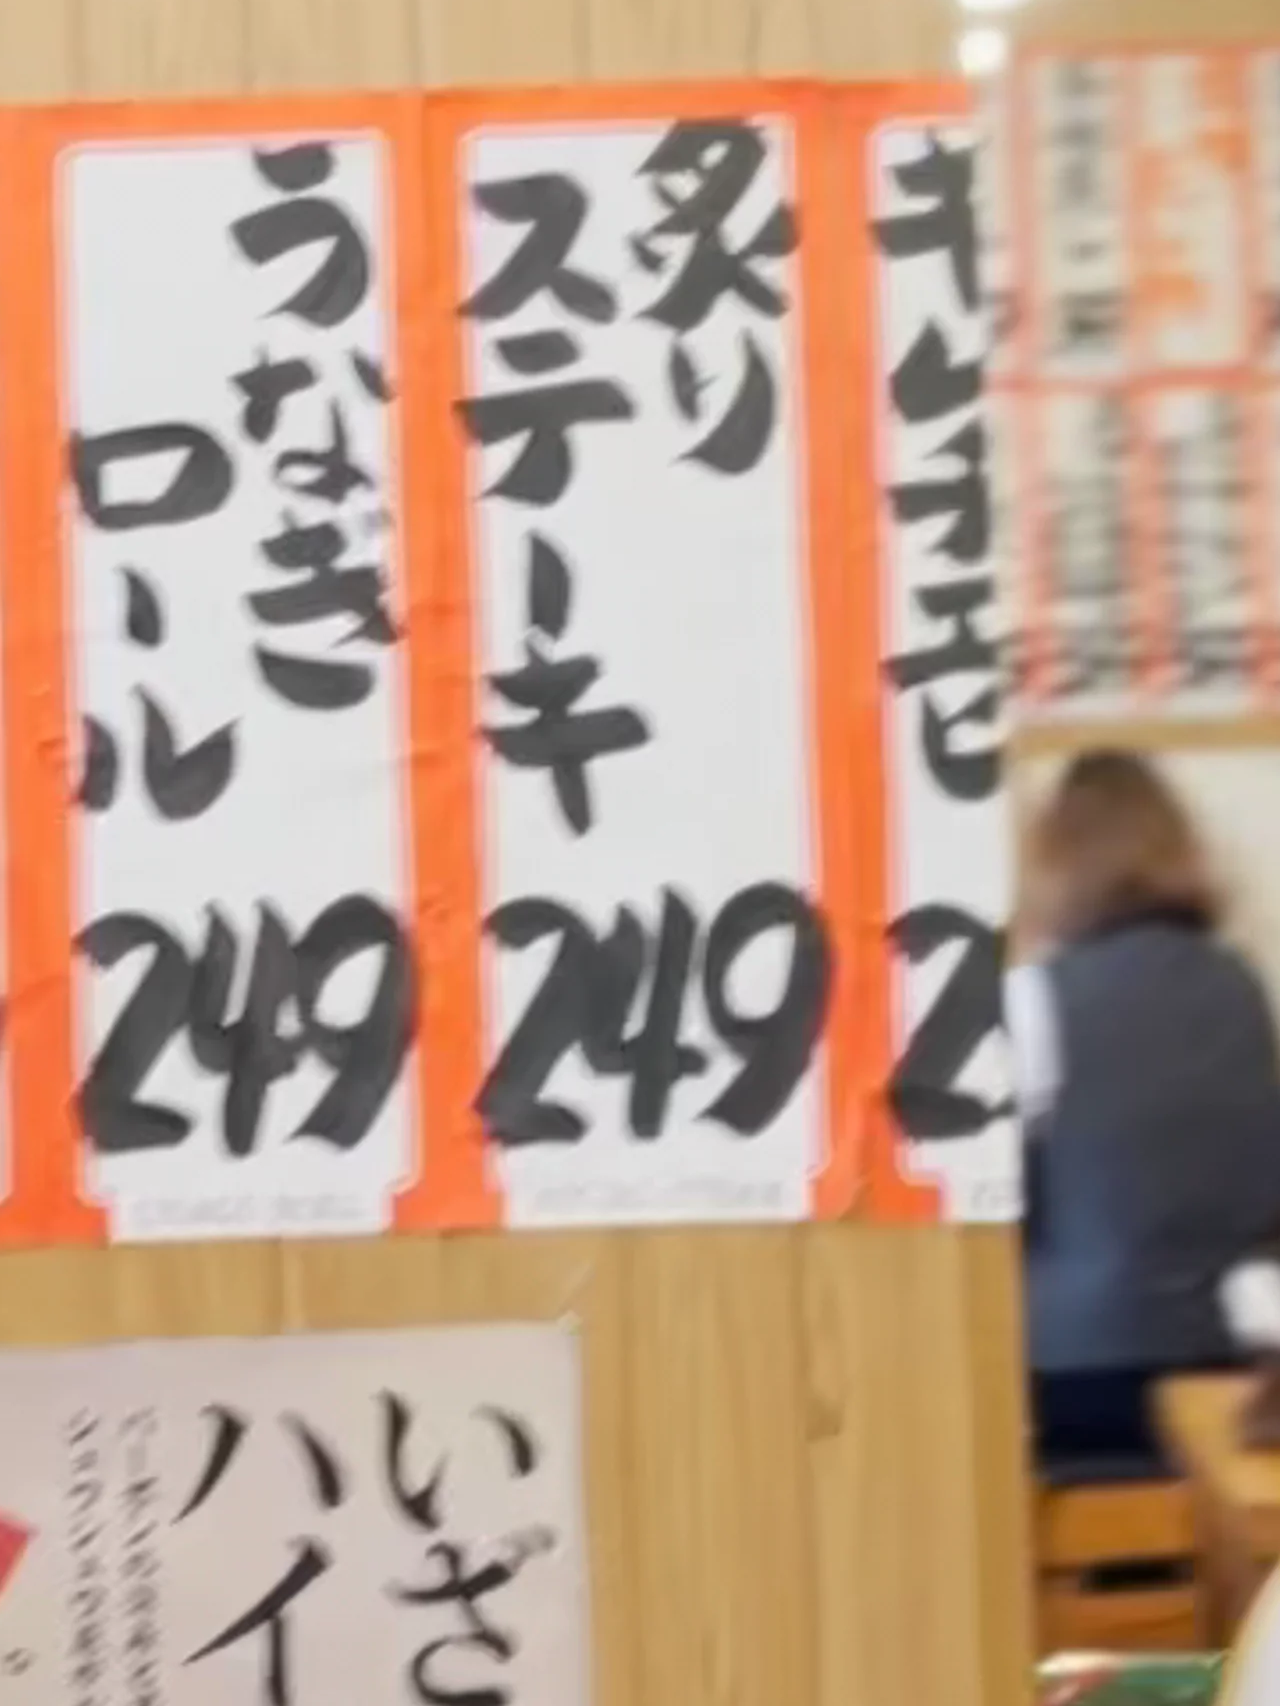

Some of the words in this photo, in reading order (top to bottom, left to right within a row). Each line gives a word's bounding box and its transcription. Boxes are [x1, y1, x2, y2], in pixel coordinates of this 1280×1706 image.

[229, 142, 404, 710] うなぎ
[632, 119, 801, 475] 炙り
[66, 422, 234, 818] ロール
[455, 173, 650, 836] ステーキ
[72, 893, 420, 1156] 249
[472, 882, 837, 1146] 249
